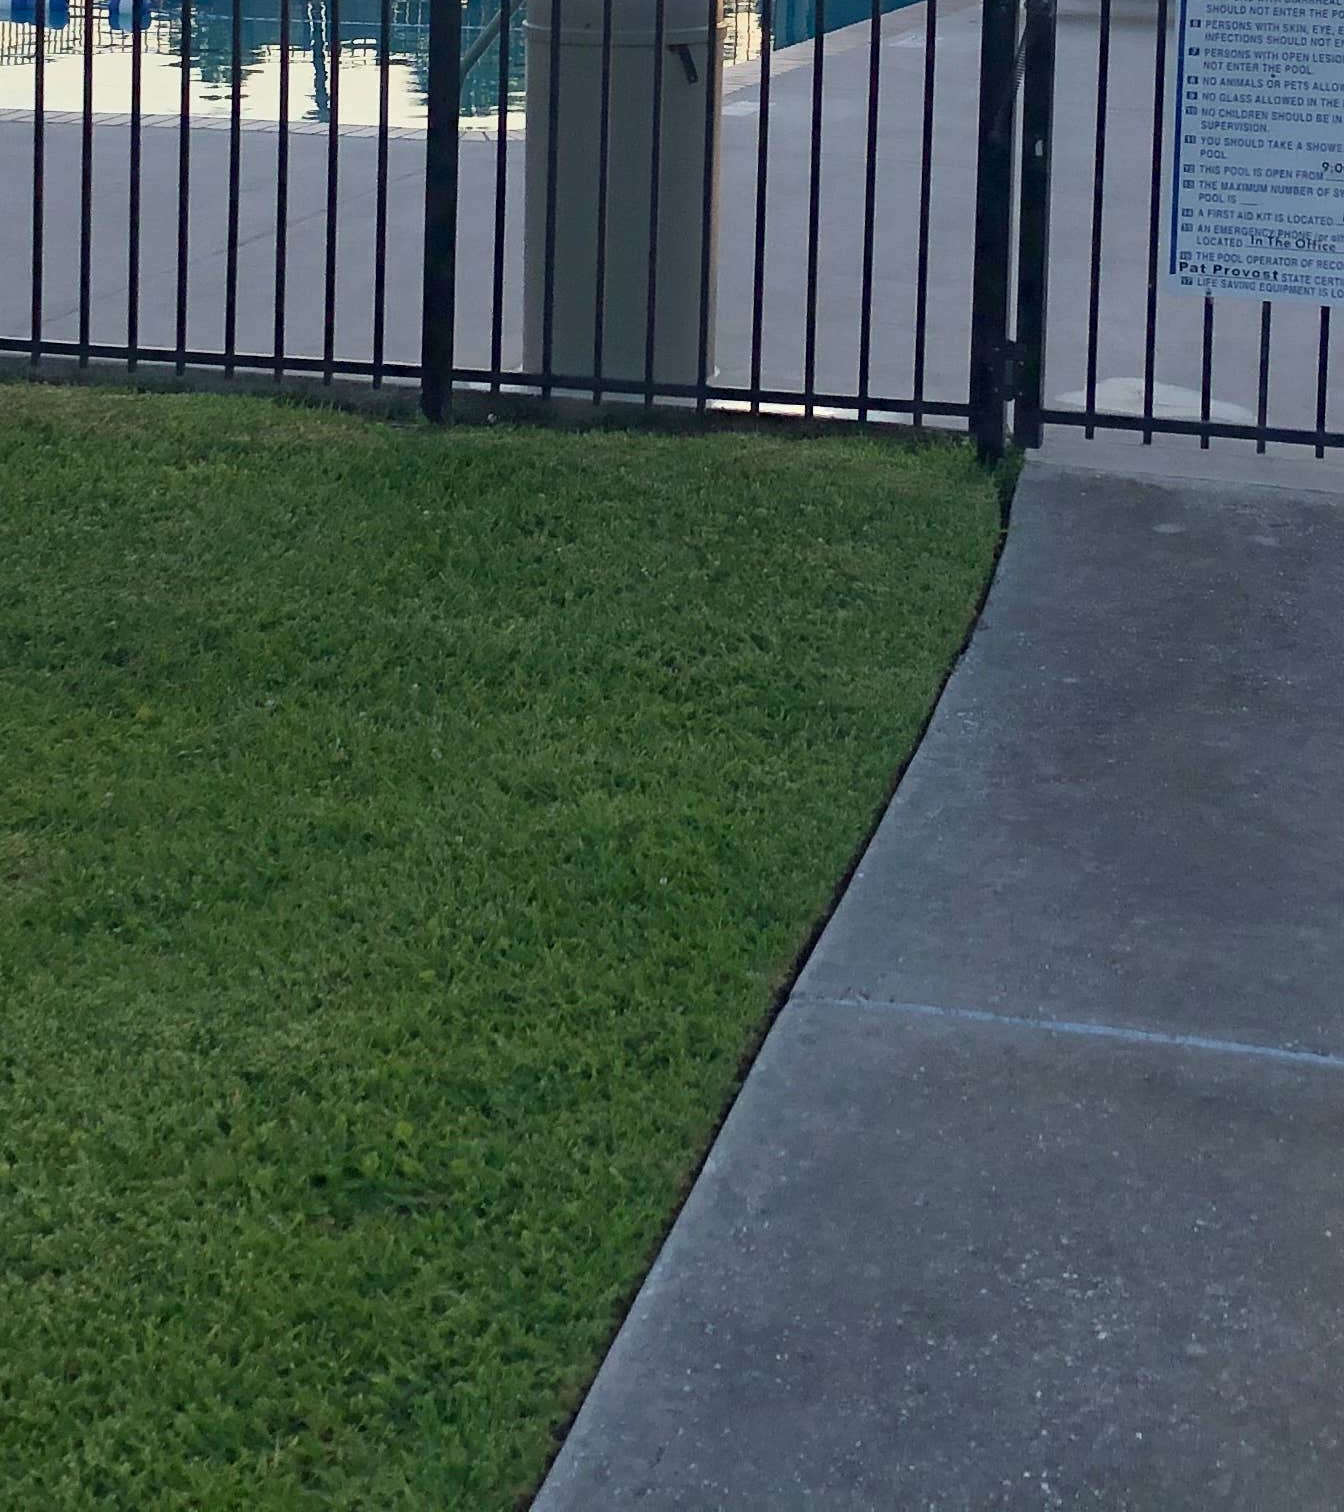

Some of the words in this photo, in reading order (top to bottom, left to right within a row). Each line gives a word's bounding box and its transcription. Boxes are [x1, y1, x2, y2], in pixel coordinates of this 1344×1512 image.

[1205, 4, 1247, 15] SHOULD
[1249, 5, 1270, 16] NOT
[1272, 6, 1306, 18] ENTER
[1308, 8, 1328, 19] THE
[1204, 32, 1263, 44] INFECTIONS
[1265, 35, 1307, 46] SHOULD
[1310, 37, 1330, 47] NOT
[1203, 47, 1251, 59] PERSONS
[1253, 50, 1279, 61] WITH
[1281, 51, 1309, 62] OPEN
[1203, 60, 1223, 70] NOT
[1226, 61, 1259, 72] ENTER
[1262, 63, 1281, 73] THE
[1219, 77, 1264, 88] ANIMALS
[1266, 79, 1281, 89] OR
[1283, 80, 1310, 90] PETS
[1218, 92, 1252, 103] GLASS
[1254, 94, 1304, 106] ALLOWED
[1320, 97, 1340, 108] THE
[1218, 108, 1268, 120] CHILDREN
[1271, 111, 1313, 122] SHOULD
[1315, 113, 1329, 123] BE
[1331, 114, 1342, 124] IN
[1200, 135, 1221, 146] YOU
[1223, 137, 1265, 149] SHOULD
[1267, 139, 1293, 150] TAKE
[1295, 141, 1303, 151] A
[1199, 164, 1221, 175] THIS
[1223, 166, 1250, 177] POOL
[1252, 167, 1262, 177] IS
[1265, 168, 1292, 179] OPEN
[1198, 208, 1204, 218] A
[1207, 209, 1234, 220] FIRST
[1236, 211, 1253, 221] AID
[1256, 212, 1272, 222] KIT
[1274, 213, 1284, 223] IS
[1286, 214, 1333, 226] LOCATED
[1178, 261, 1207, 274] Pat
[1212, 263, 1279, 281] Provost
